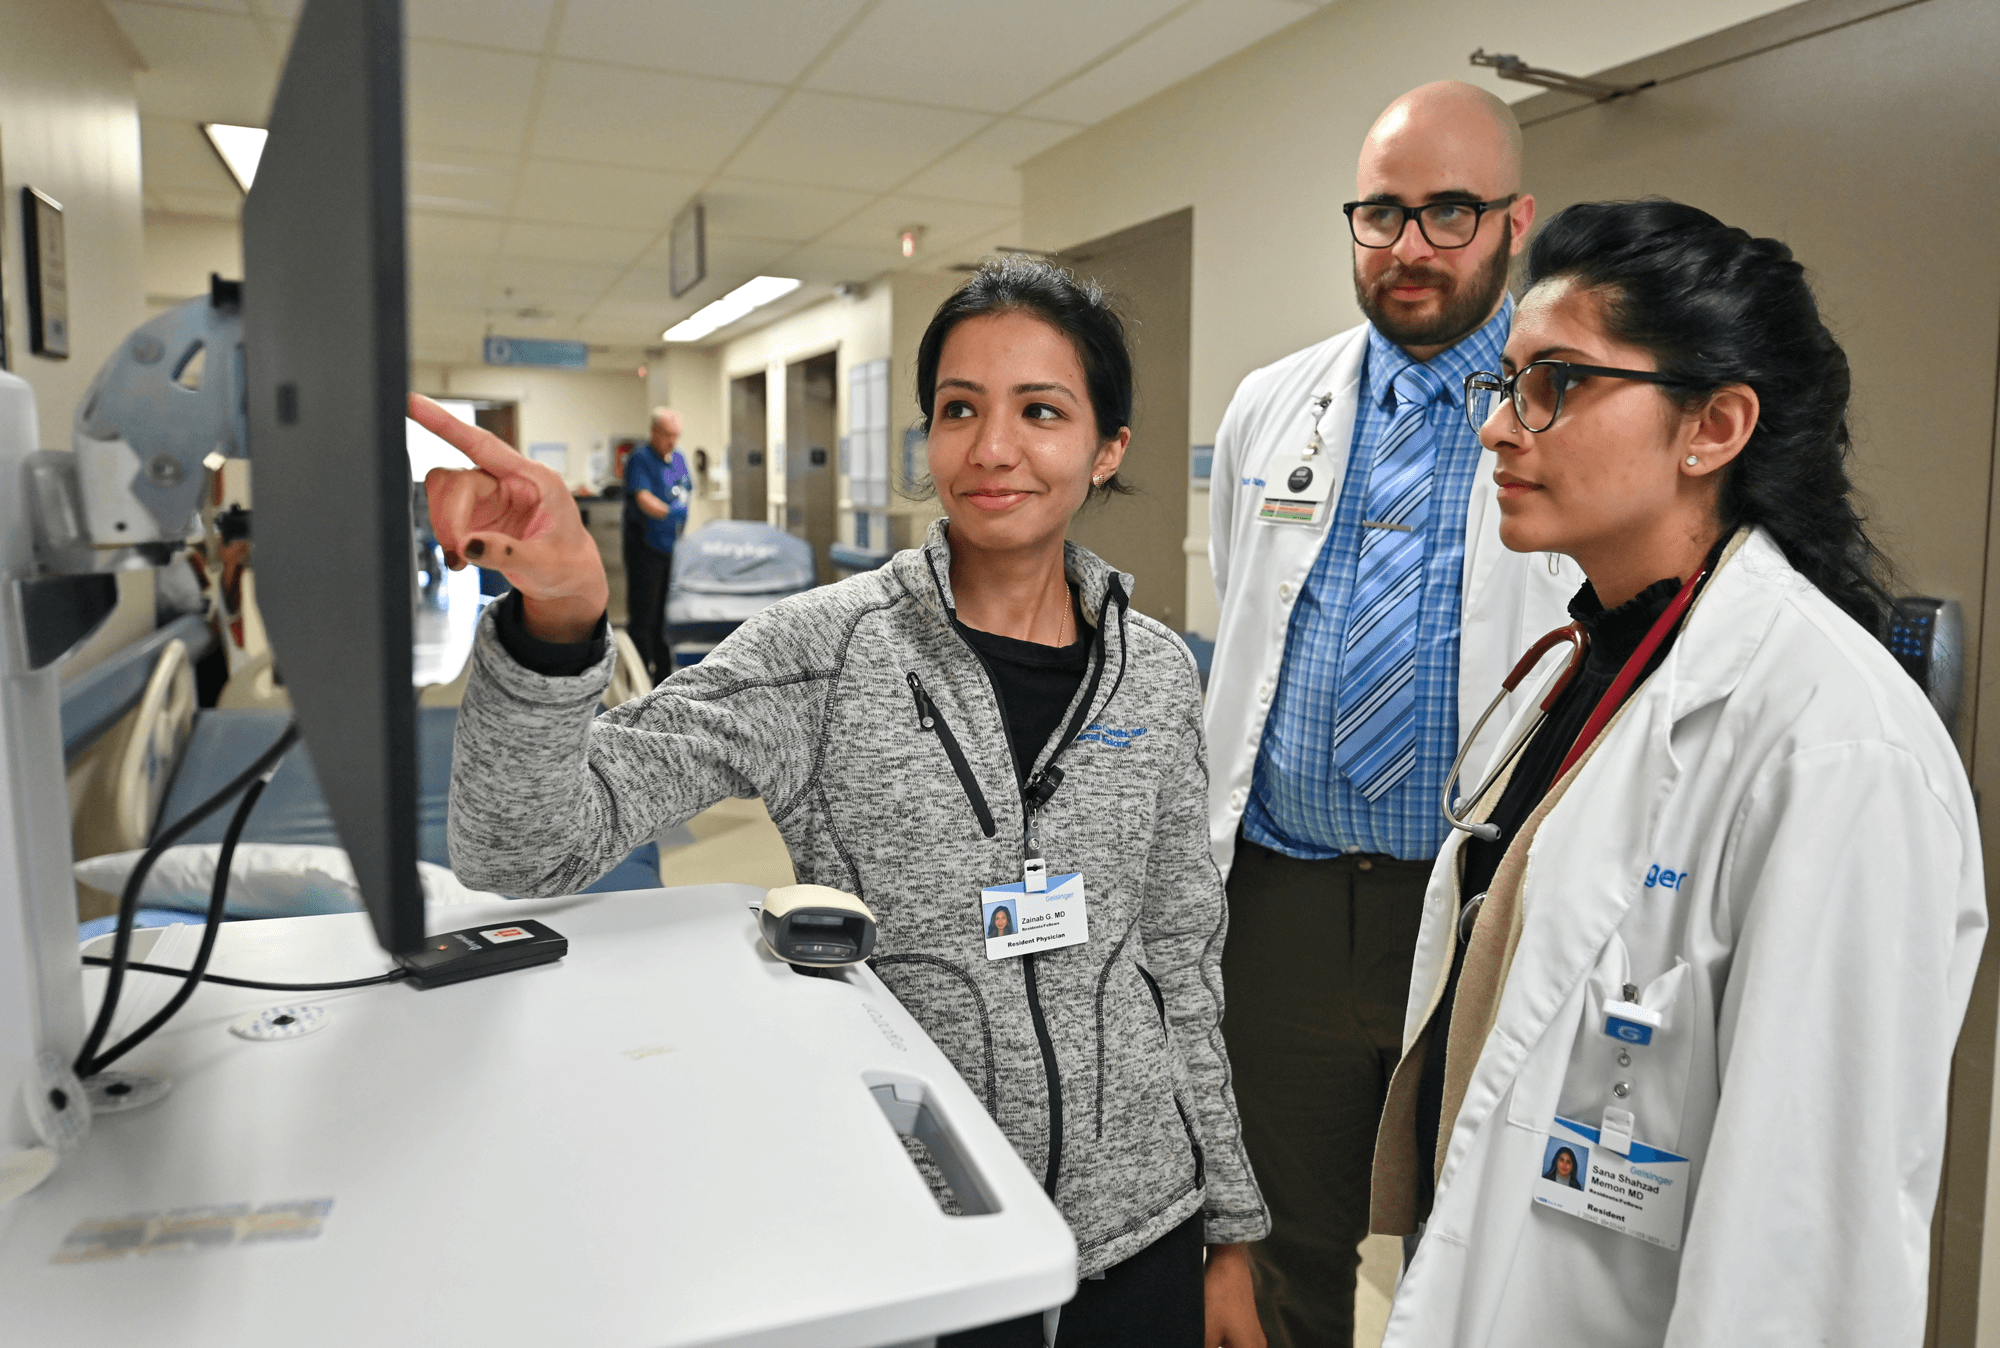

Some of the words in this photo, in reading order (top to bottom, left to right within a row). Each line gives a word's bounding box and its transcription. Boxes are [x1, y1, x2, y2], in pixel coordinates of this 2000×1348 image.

[1046, 892, 1074, 902] Geisinger
[1022, 915, 1045, 925] Zainab
[1045, 913, 1053, 921] G.
[1055, 911, 1066, 919] MD
[1008, 938, 1035, 947] Resident
[1036, 933, 1066, 942] Physician
[1592, 1165, 1616, 1180] Sana
[1618, 1173, 1660, 1195] Shahzad
[1629, 1166, 1674, 1187] Geisinger
[1591, 1176, 1626, 1195] Memon
[1627, 1188, 1644, 1201] MD
[1586, 1203, 1626, 1223] Resident
